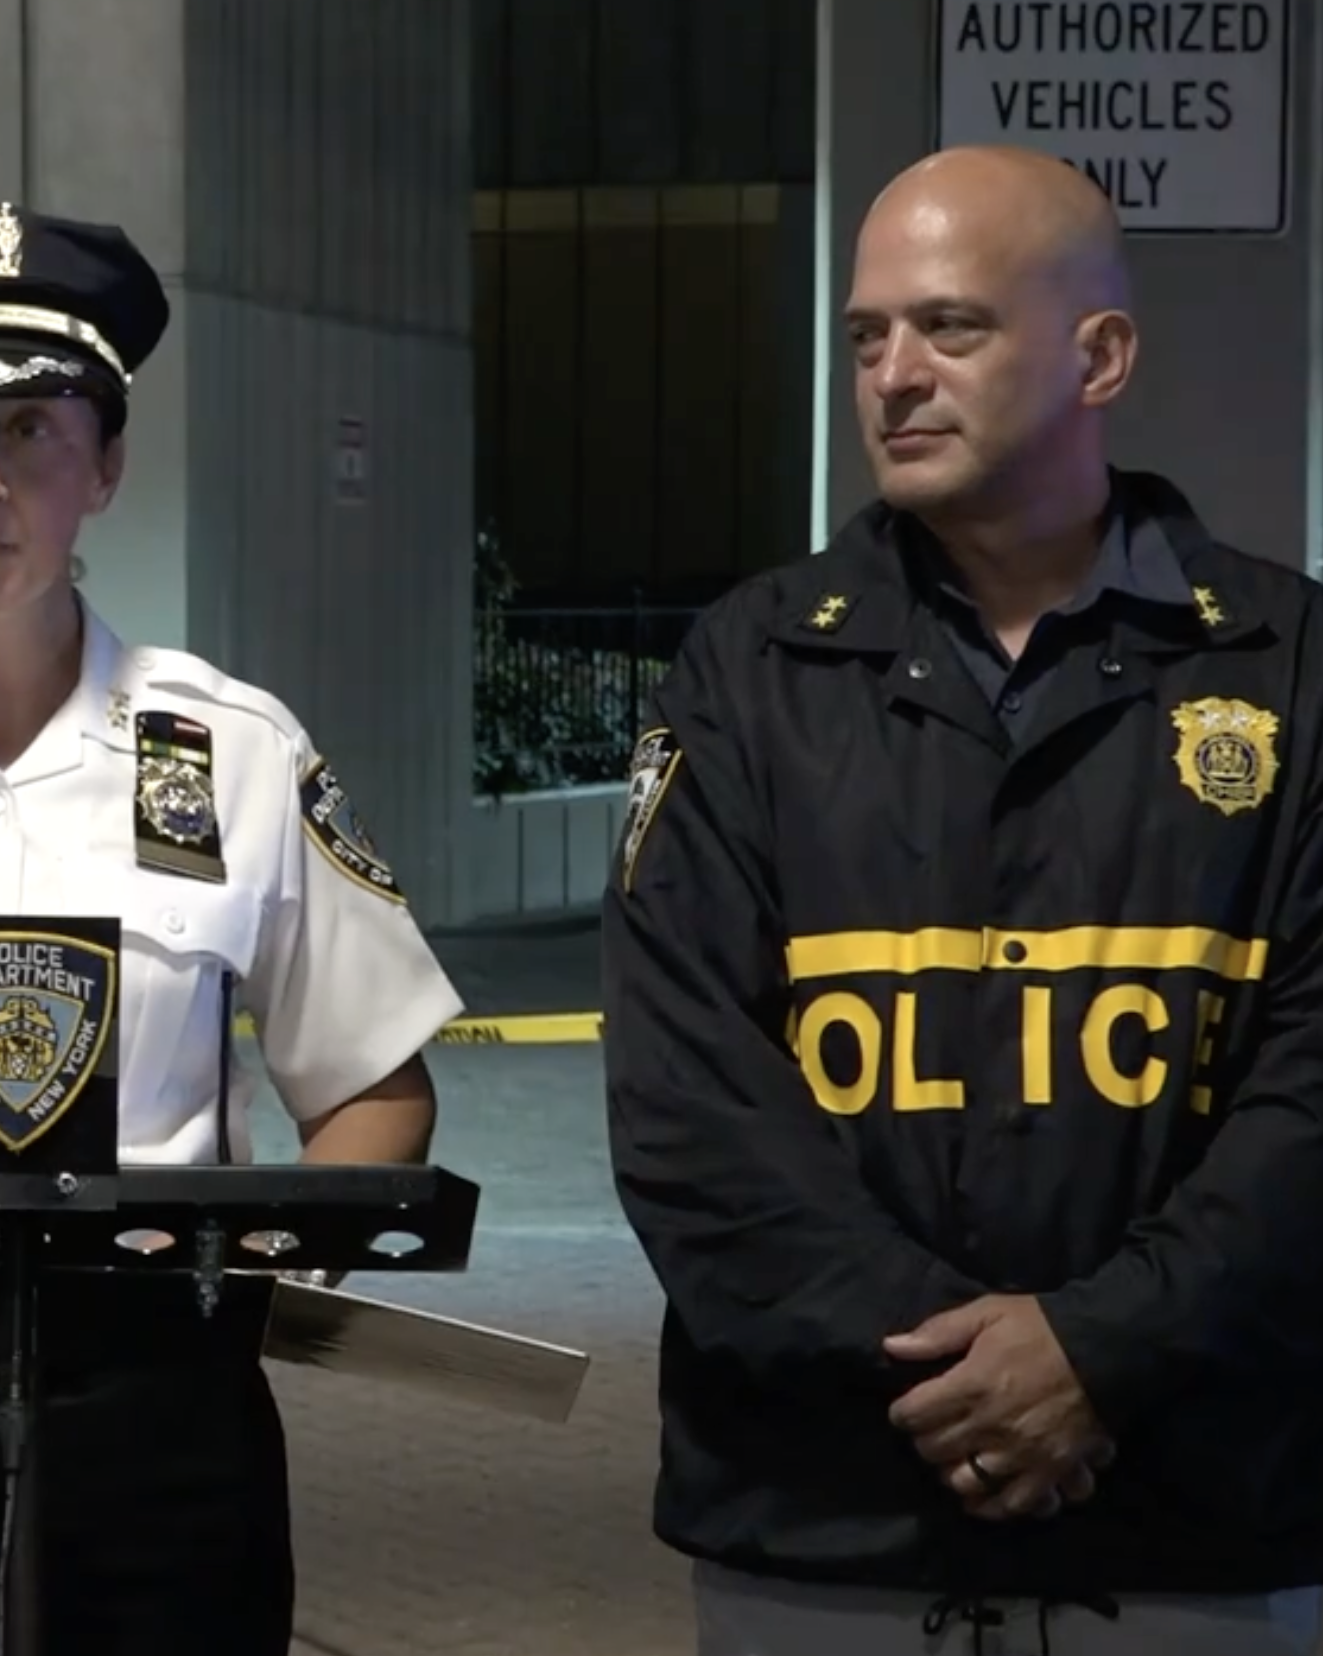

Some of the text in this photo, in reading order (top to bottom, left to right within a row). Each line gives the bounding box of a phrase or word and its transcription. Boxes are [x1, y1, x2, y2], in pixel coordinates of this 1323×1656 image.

[957, 2, 1269, 51] AUTHORIZED
[990, 80, 1232, 130] VEHICLES
[1063, 158, 1168, 208] NLY
[28, 1018, 98, 1121] NEW YORK
